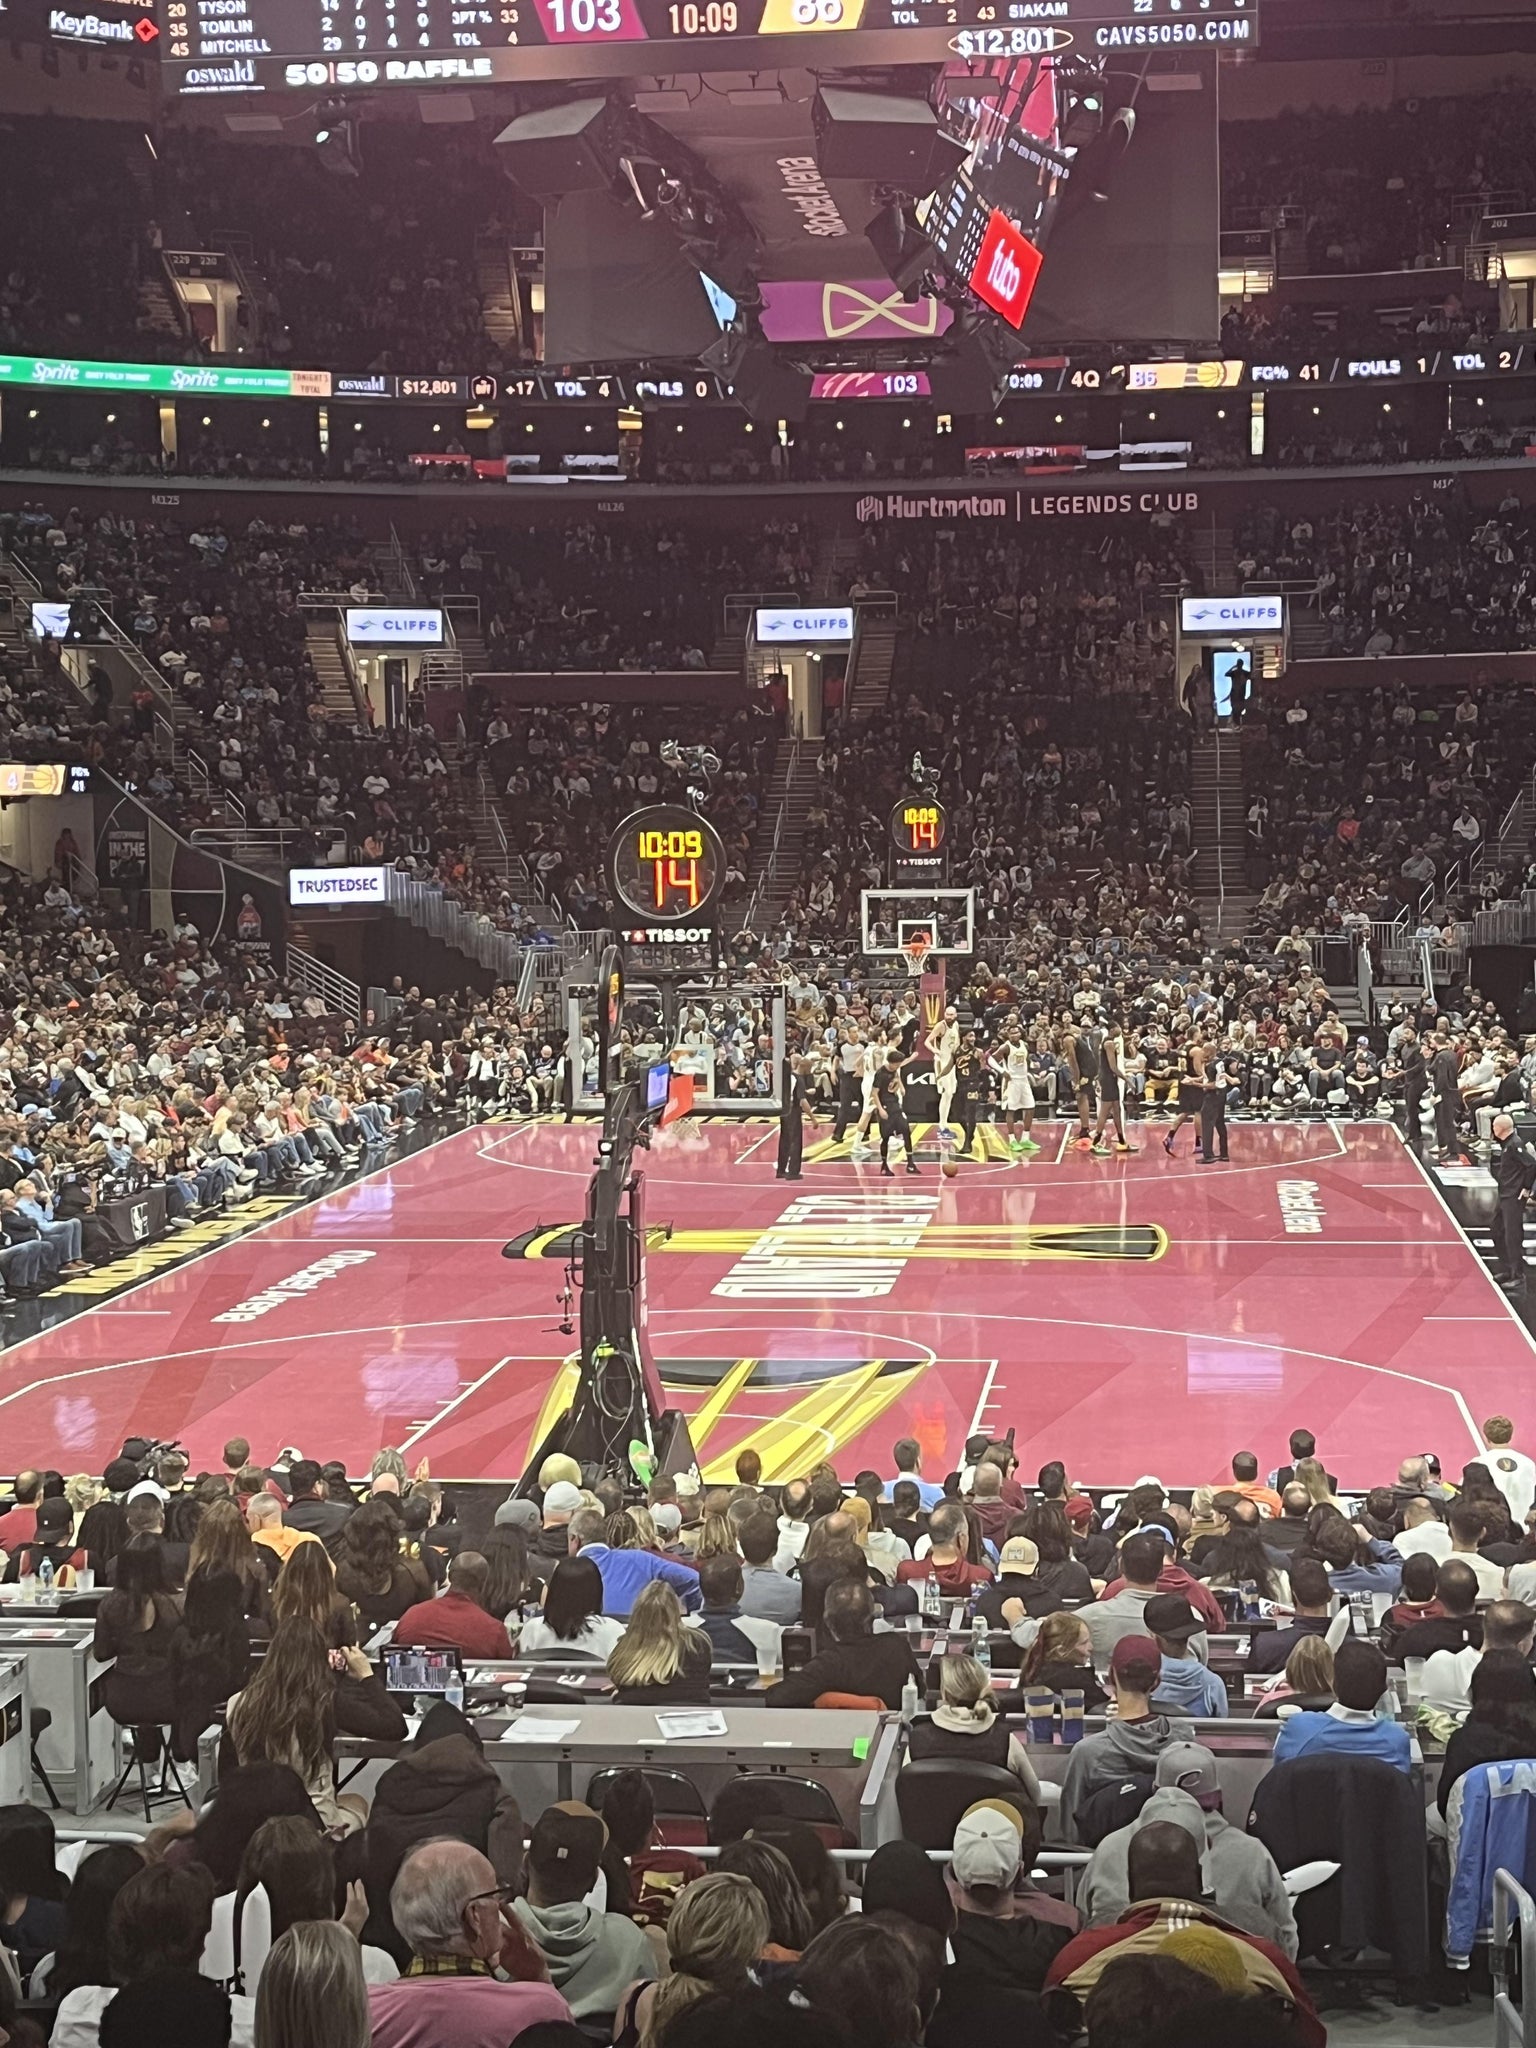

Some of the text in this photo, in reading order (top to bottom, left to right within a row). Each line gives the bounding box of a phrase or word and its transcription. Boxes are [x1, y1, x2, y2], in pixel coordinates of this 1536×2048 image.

[168, 4, 186, 17] 20
[197, 1, 246, 15] TYSON
[547, 0, 621, 33] 103
[669, 2, 737, 34] 10:09
[891, 2, 1068, 24] TOL 2 43 SIAKAM
[50, 10, 133, 41] KeyBank
[169, 23, 188, 37] 35
[199, 20, 253, 35] TOMLIN
[322, 17, 332, 31] 2
[355, 15, 366, 30] 0
[388, 15, 395, 29] 1
[417, 13, 429, 28] 0
[452, 11, 476, 24] 3PT
[500, 9, 518, 24] 33
[1096, 20, 1249, 46] CAVS5050.COM
[170, 31, 518, 56] 45 MITCHELL 29 7 4 4 TOL 4
[957, 27, 1055, 58] $12,801
[185, 60, 254, 84] oswald
[386, 58, 492, 80] RAFFLE
[776, 156, 829, 194] Arena
[33, 362, 80, 384] Sprite
[1252, 352, 1511, 381] FG% 41 FOULS 1 TOL 2
[171, 370, 219, 390] Sprite
[338, 376, 384, 391] oswald
[403, 379, 457, 396] $12,801
[554, 381, 586, 396] TOL
[599, 381, 610, 397] 4
[696, 381, 707, 397] 0
[883, 375, 918, 394] 103
[1071, 370, 1100, 388] 4Q
[1030, 495, 1132, 515] LEGENDS
[793, 618, 848, 630] CLIFFS
[1219, 607, 1277, 619] CLIFFS
[383, 620, 438, 631] CLIFFS
[904, 807, 938, 824] 10:09
[639, 830, 703, 858] 10:09
[912, 824, 935, 849] 14
[909, 858, 943, 867] TISSOT
[298, 878, 378, 893] TRUSTEDSEC
[655, 859, 699, 908] 14
[645, 929, 713, 943] TISSOT
[710, 1194, 942, 1299] CLEVELAND
[210, 1290, 308, 1323] Arena
